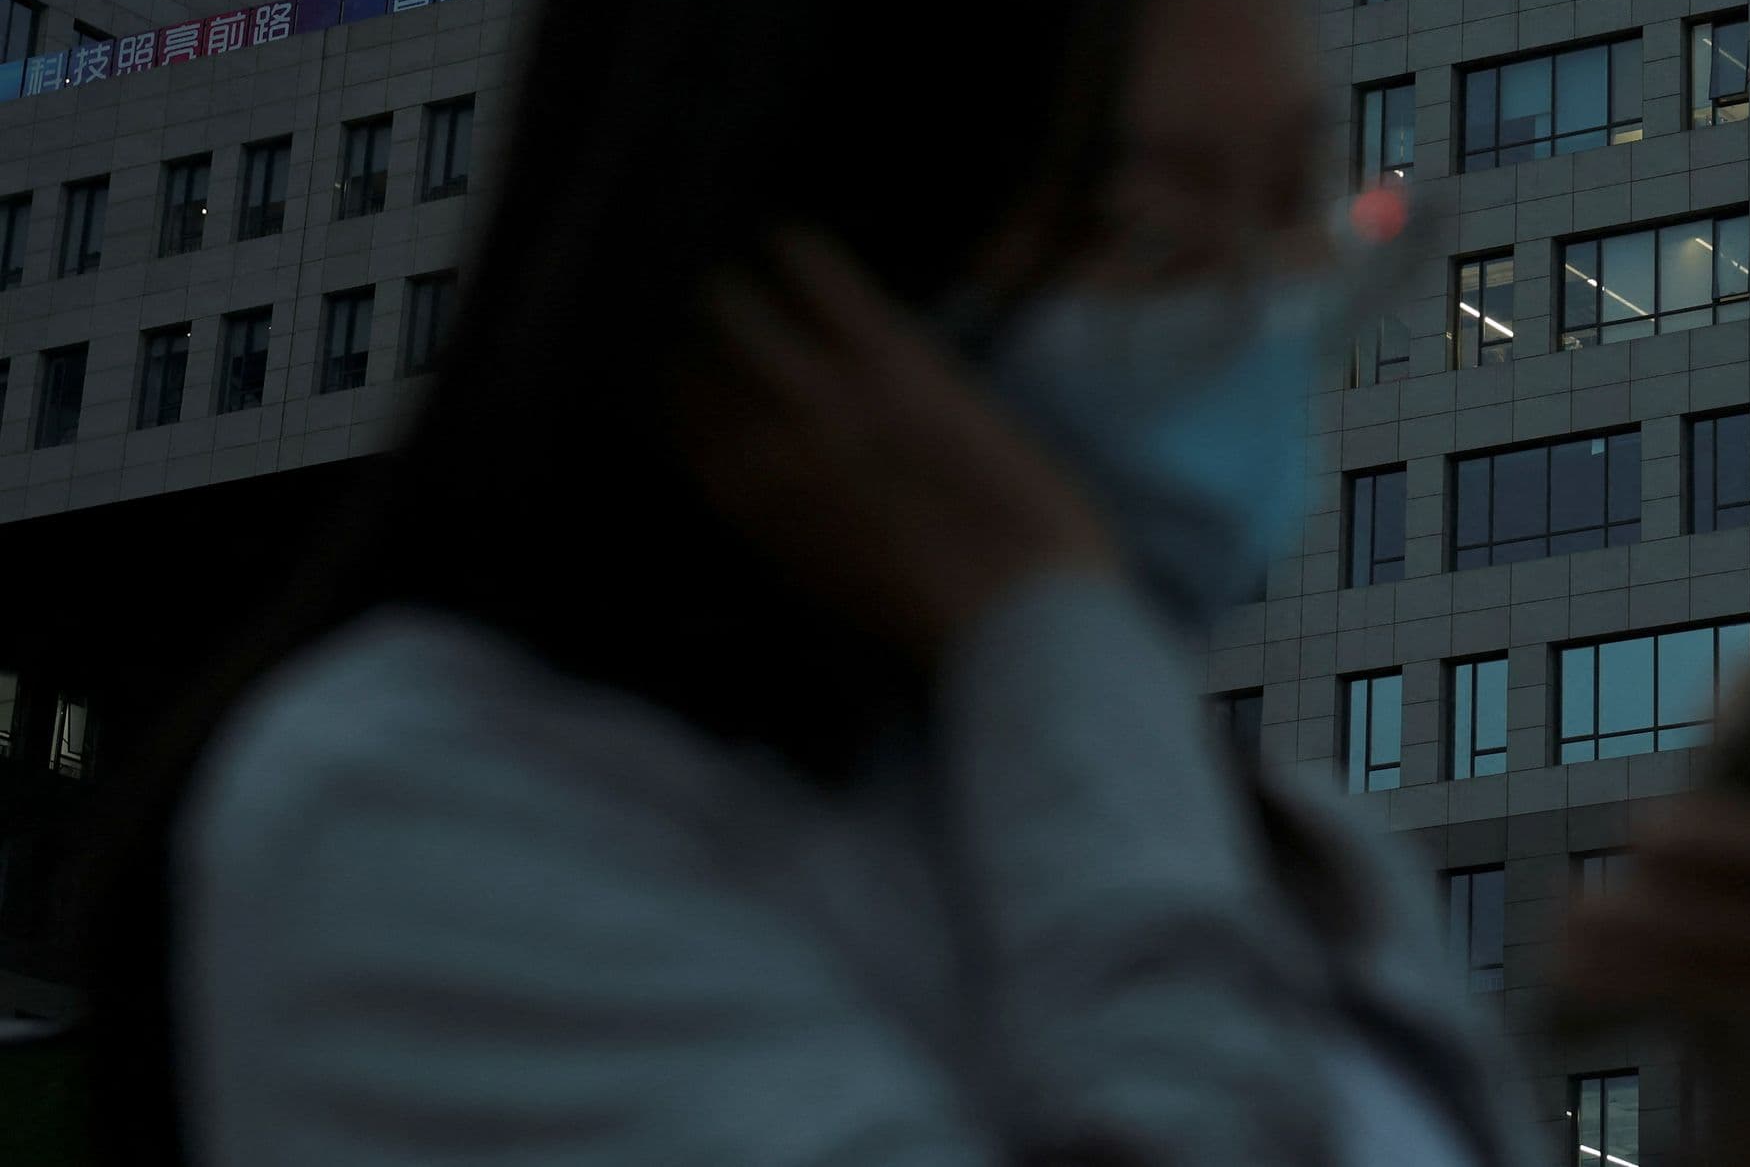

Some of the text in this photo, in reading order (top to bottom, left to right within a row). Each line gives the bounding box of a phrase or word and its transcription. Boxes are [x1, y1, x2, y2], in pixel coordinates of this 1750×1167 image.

[26, 1, 293, 97] 科技照亮前路
